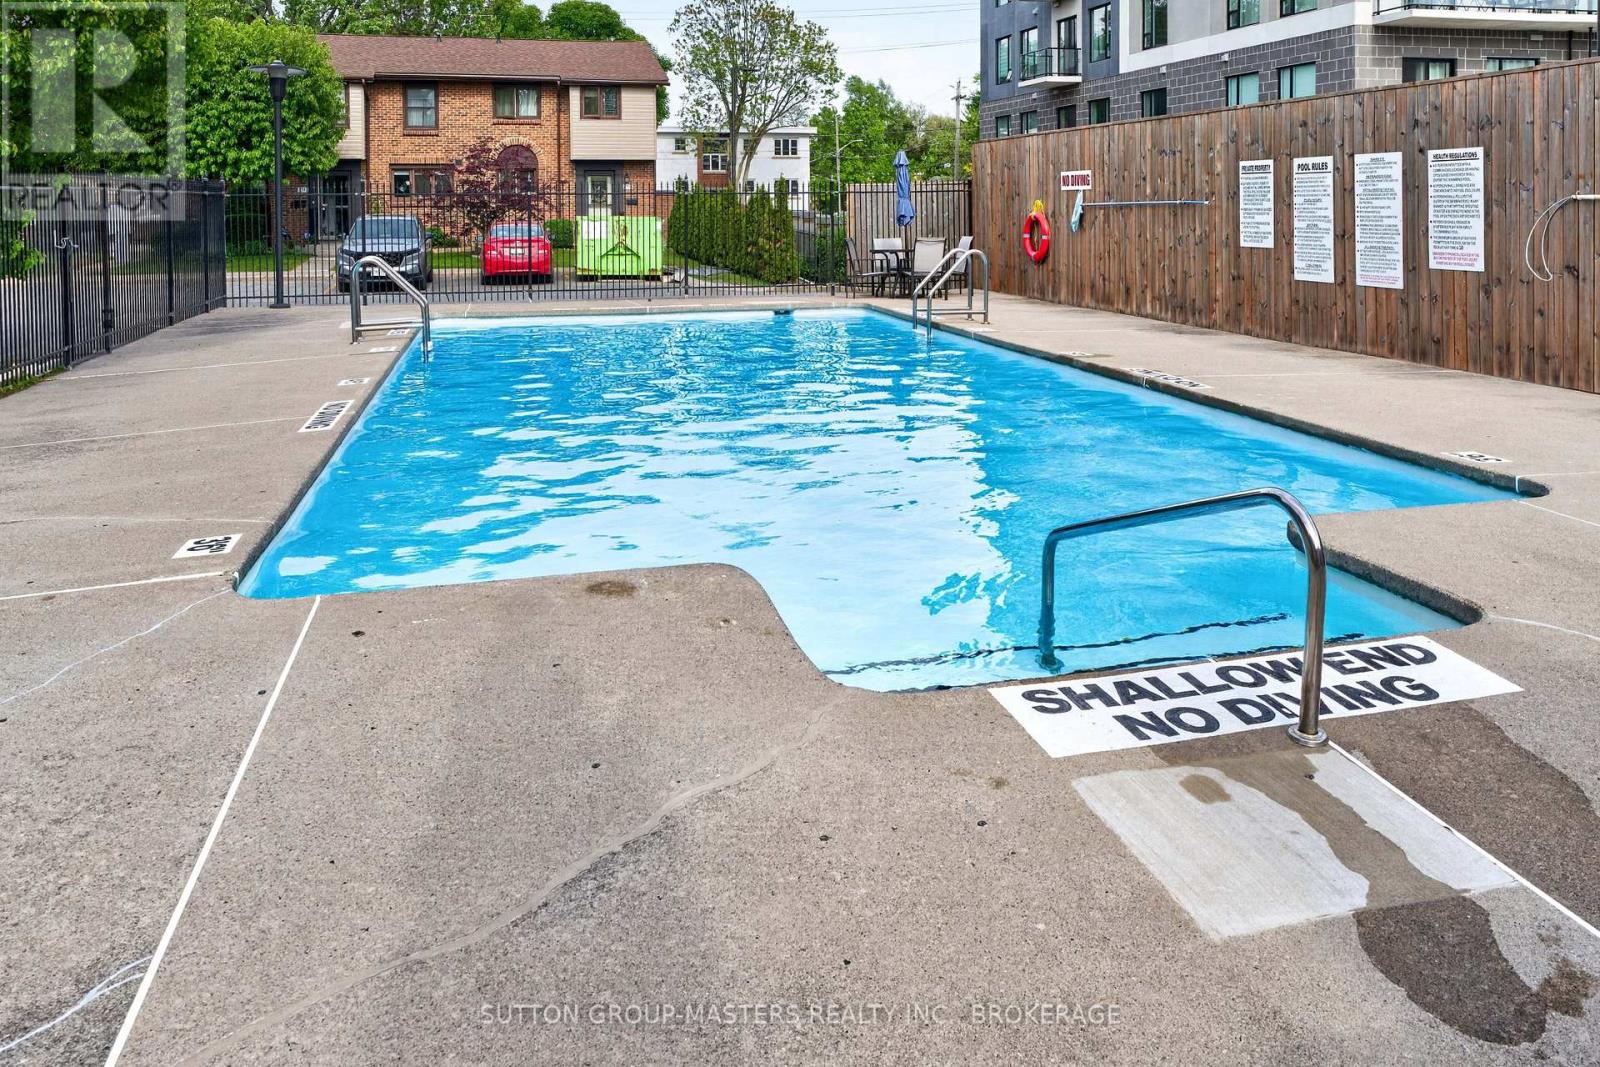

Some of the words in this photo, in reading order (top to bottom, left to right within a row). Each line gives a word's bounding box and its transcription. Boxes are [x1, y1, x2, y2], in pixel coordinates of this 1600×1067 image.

[1449, 151, 1478, 159] REGULATIONS
[1297, 163, 1311, 171] POOL
[1312, 162, 1329, 171] RULES
[1062, 175, 1070, 187] NO
[1071, 174, 1090, 186] DIVING
[1021, 657, 1303, 714] SHALLOW
[1322, 643, 1437, 675] END
[1112, 706, 1220, 740] NO
